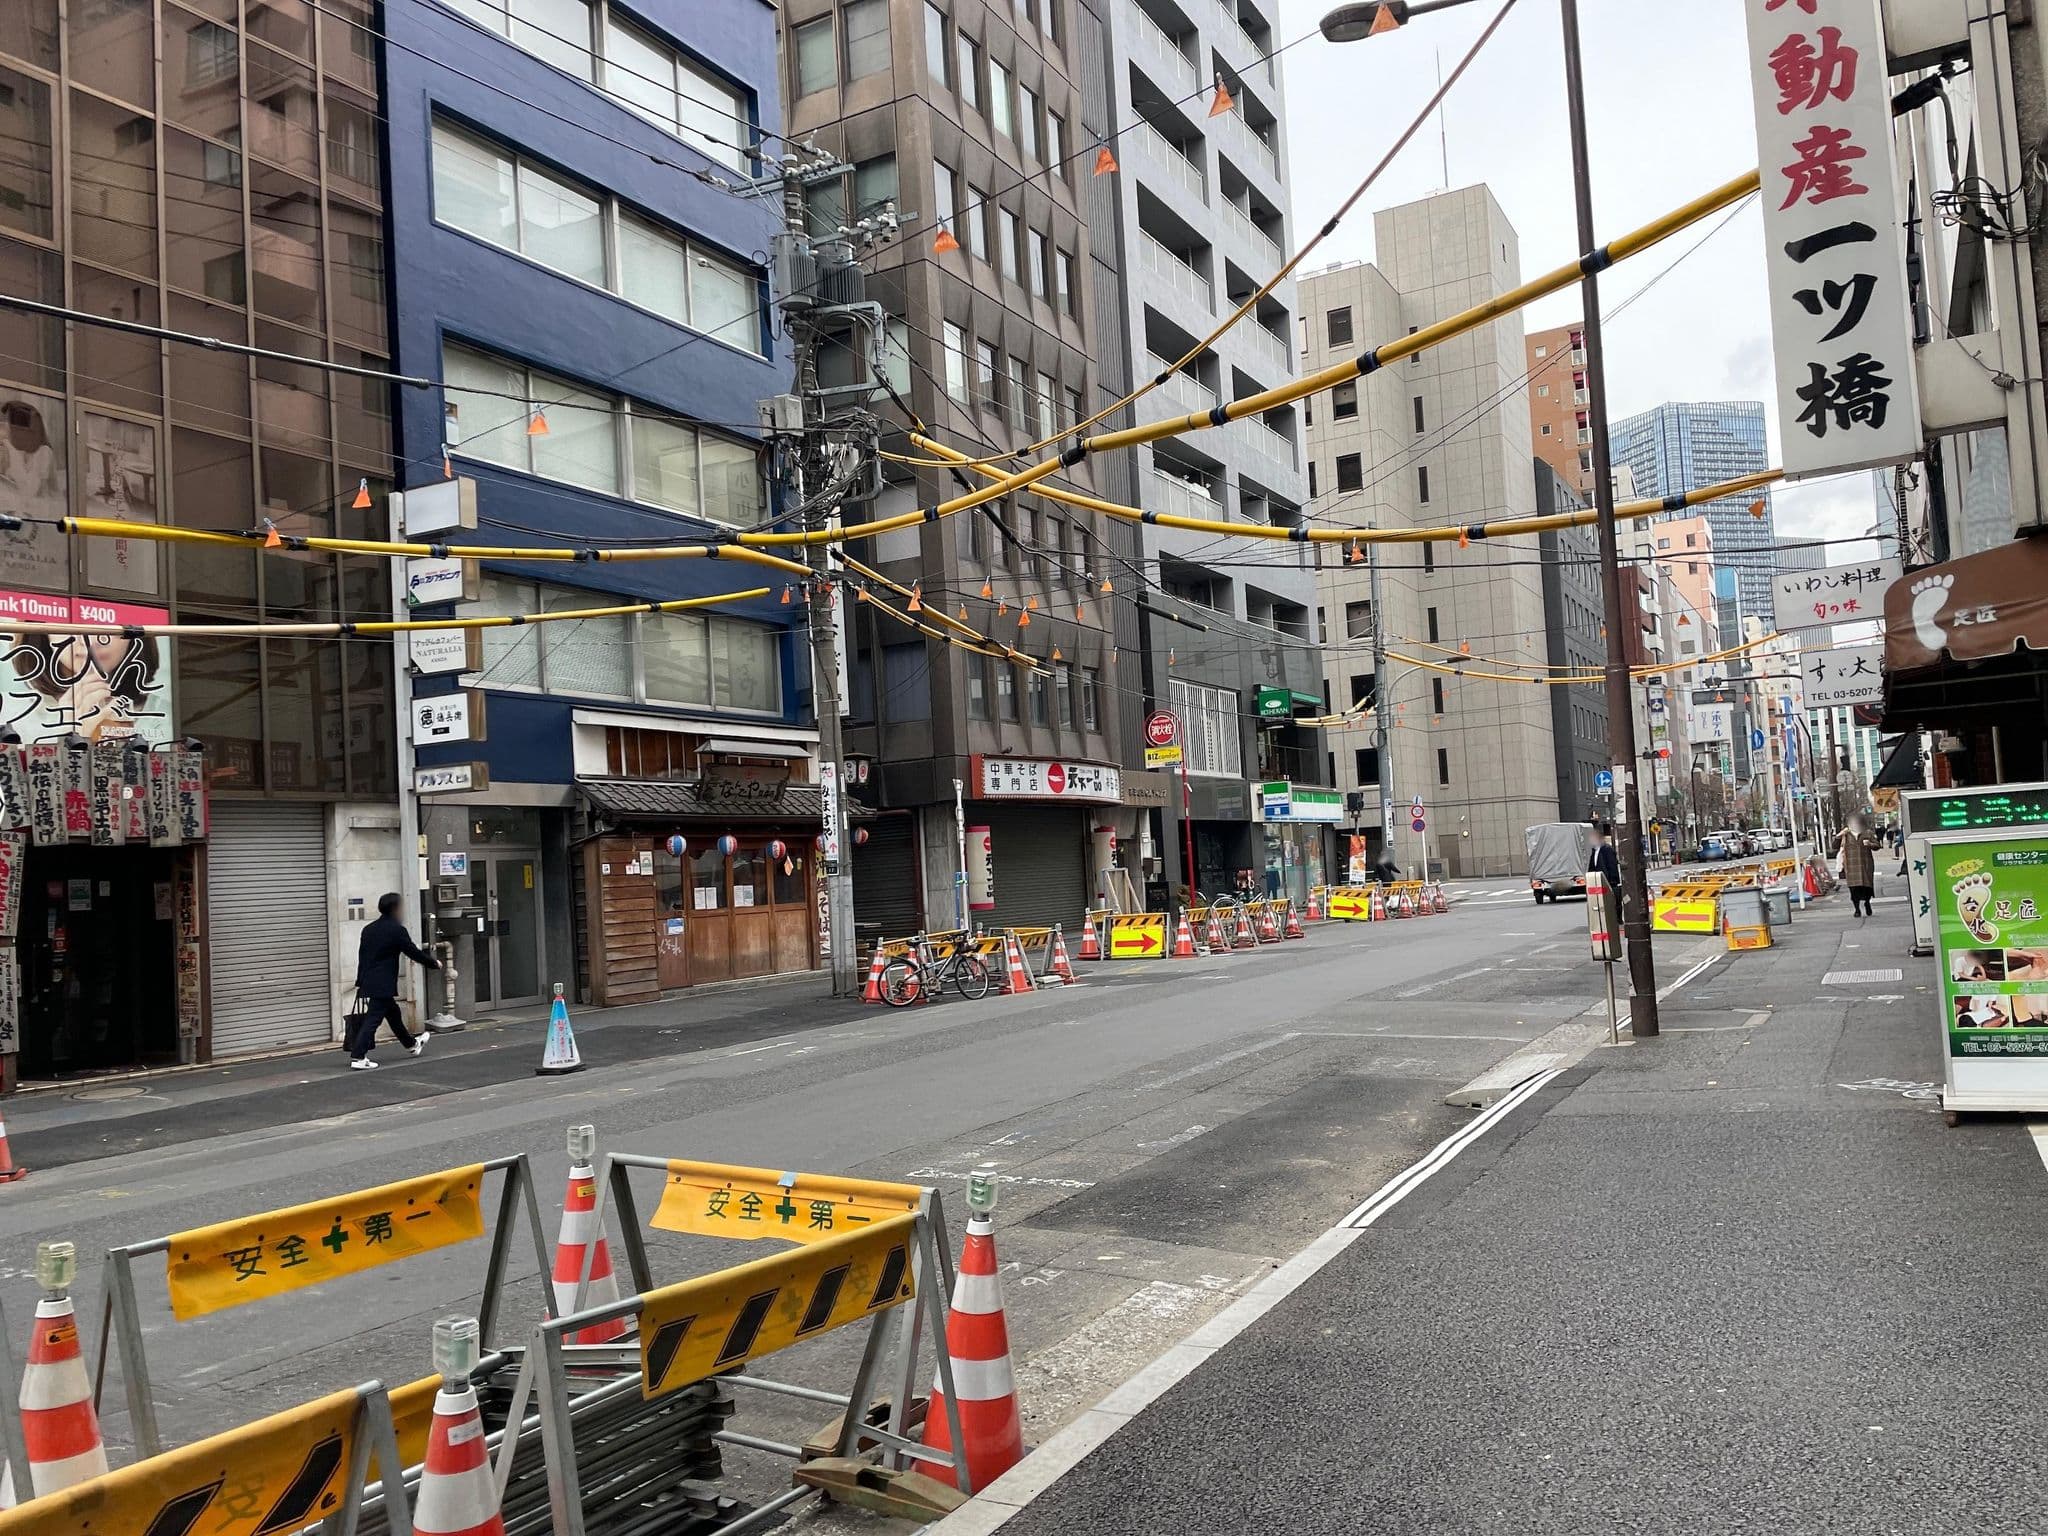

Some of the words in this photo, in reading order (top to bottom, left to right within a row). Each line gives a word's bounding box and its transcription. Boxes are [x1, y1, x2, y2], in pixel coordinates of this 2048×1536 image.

[1766, 0, 1893, 439] 動産一ツ橋
[1783, 566, 1886, 594] いわし料理
[79, 604, 116, 624] ¥400
[1813, 598, 1861, 620] 旬の味
[0, 632, 164, 690] っぴん
[0, 690, 166, 728] フェバー
[1811, 691, 1831, 702] TEL
[1151, 723, 1173, 737] 消火栓
[990, 763, 1038, 777] 中華そば
[990, 777, 1039, 792] 専門店
[705, 1187, 763, 1221] 安全
[809, 1199, 872, 1231] 第一
[222, 1235, 309, 1282] 安全
[363, 1210, 433, 1246] 第一
